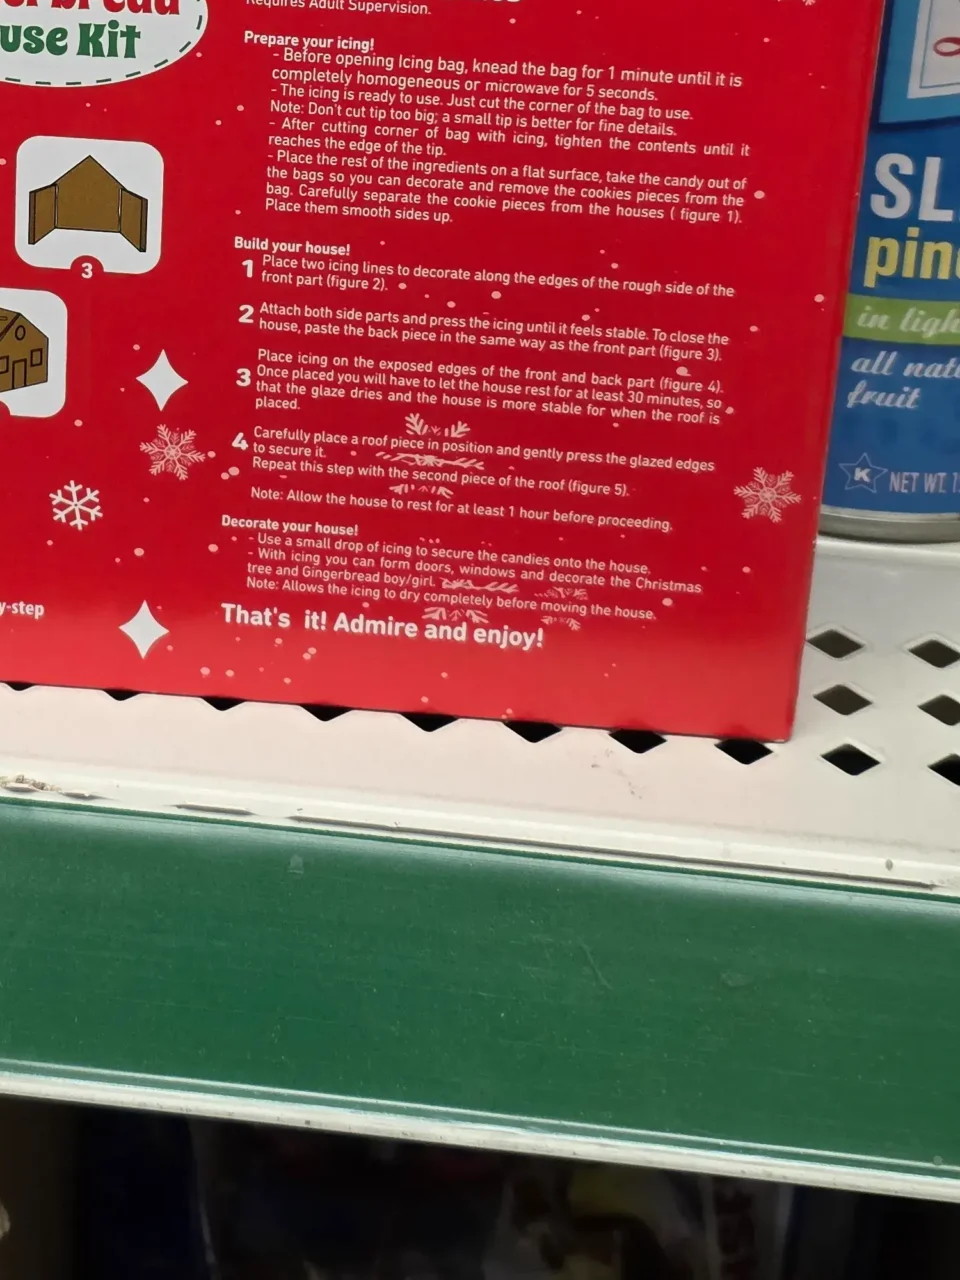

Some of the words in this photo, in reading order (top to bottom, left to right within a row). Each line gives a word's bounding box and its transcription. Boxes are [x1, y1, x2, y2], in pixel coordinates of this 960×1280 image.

[76, 19, 141, 59] Kit
[245, 30, 299, 48] Prepare
[303, 37, 334, 54] your
[338, 36, 374, 54] icing!
[235, 236, 268, 250] Build
[272, 242, 302, 254] your
[305, 240, 350, 256] house!
[864, 227, 960, 287] pin
[82, 262, 92, 279] 3
[243, 259, 253, 278] 1
[239, 304, 254, 324] 2
[851, 350, 898, 376] all
[236, 367, 251, 387] 3
[847, 380, 921, 409] fruit
[232, 432, 248, 450] 4
[890, 472, 919, 493] NET
[222, 515, 279, 531] Decorate
[283, 522, 312, 533] your
[315, 522, 358, 536] house!
[221, 603, 290, 629] That's
[305, 609, 326, 631] it!
[334, 612, 418, 638] Admire
[424, 621, 467, 642] and
[474, 625, 543, 651] enjoy!
